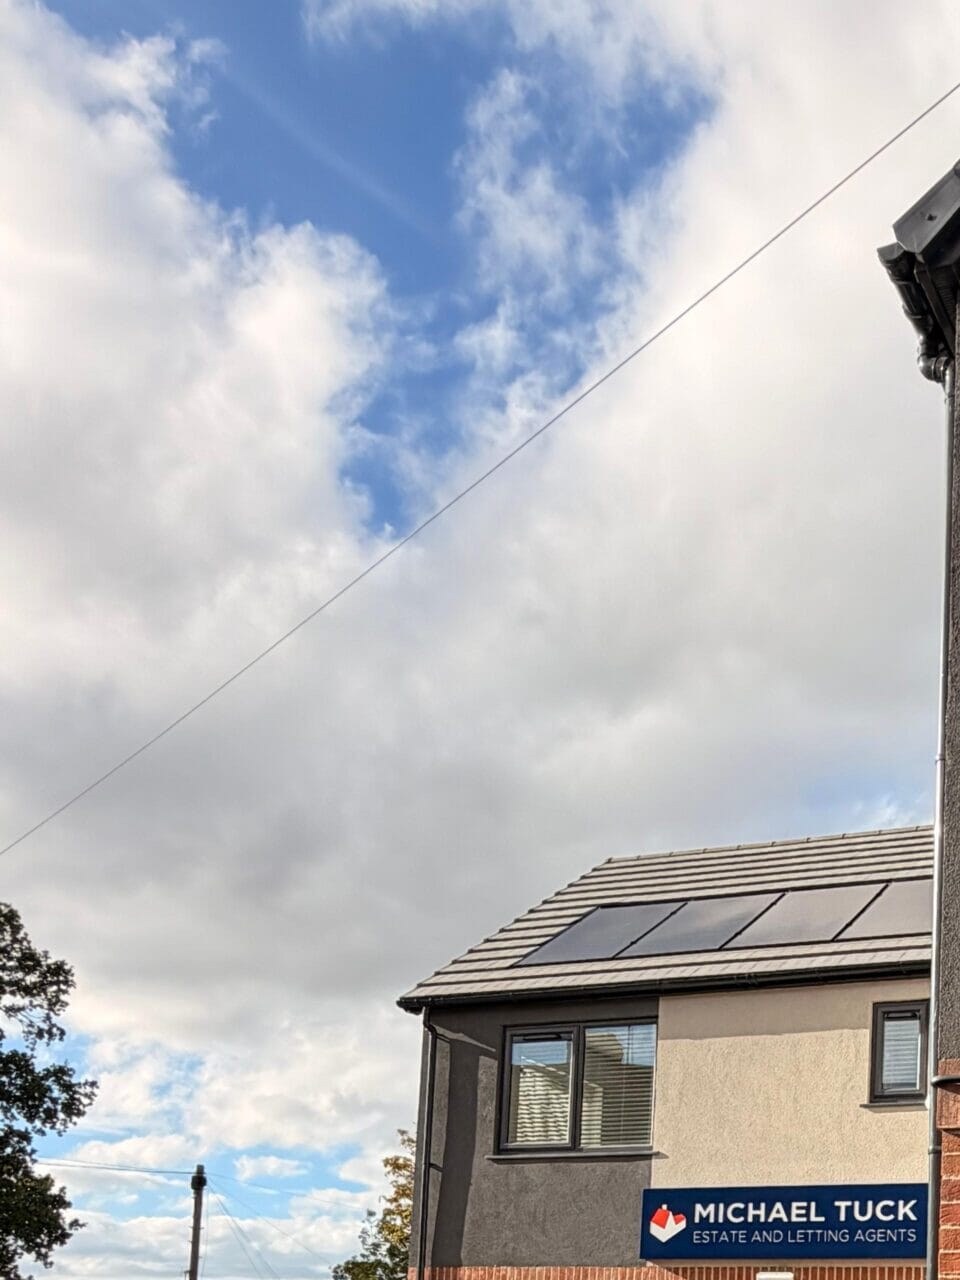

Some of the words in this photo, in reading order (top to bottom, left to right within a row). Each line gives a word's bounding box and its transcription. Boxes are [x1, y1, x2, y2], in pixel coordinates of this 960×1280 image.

[693, 1200, 826, 1224] MICHAEL
[834, 1199, 918, 1222] TUCK
[693, 1230, 747, 1243] ESTATE
[751, 1230, 784, 1243] AND
[788, 1229, 850, 1243] LETTING
[854, 1228, 917, 1242] AGENTS
